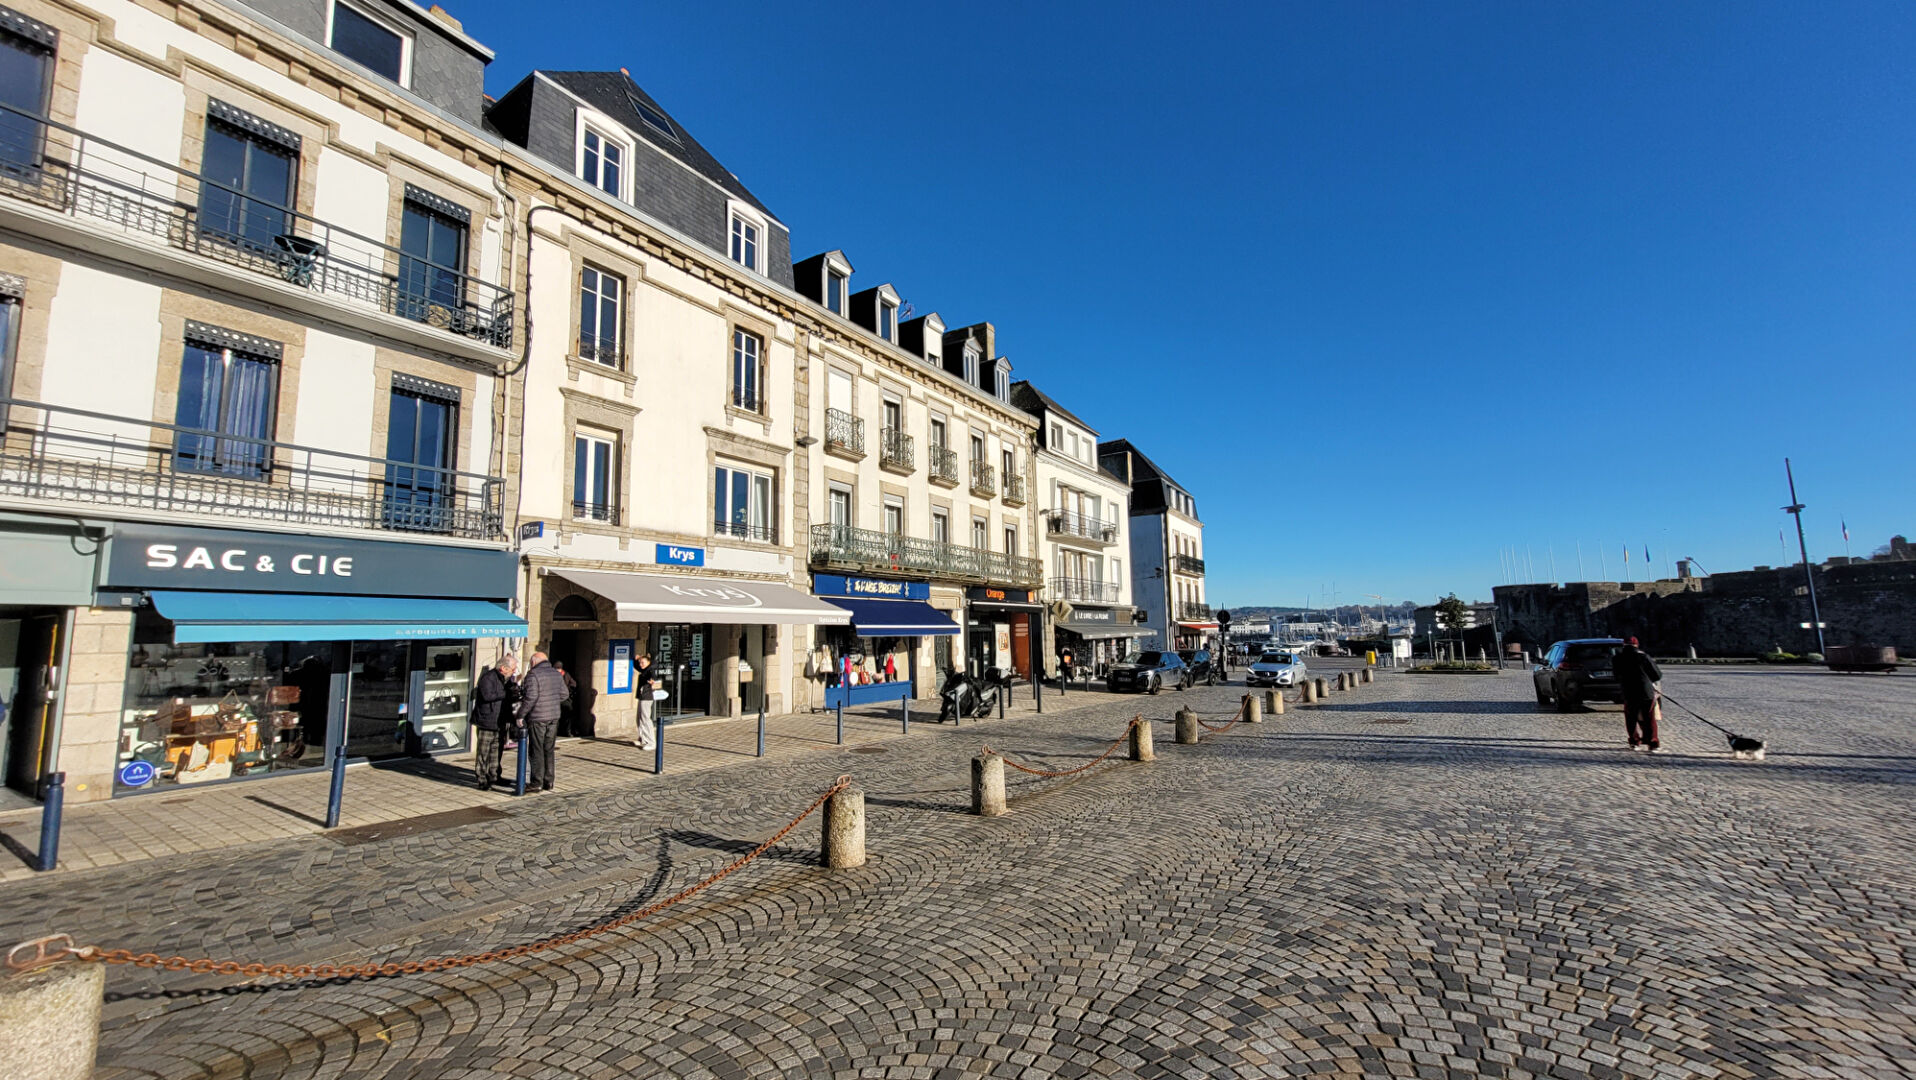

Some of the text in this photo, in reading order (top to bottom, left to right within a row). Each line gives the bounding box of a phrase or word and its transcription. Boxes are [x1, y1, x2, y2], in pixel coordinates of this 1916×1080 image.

[147, 544, 353, 577] SAC & CIE
[669, 547, 695, 562] Krys
[660, 584, 746, 600] Krys
[986, 589, 1005, 600] Orange
[660, 635, 671, 650] B
